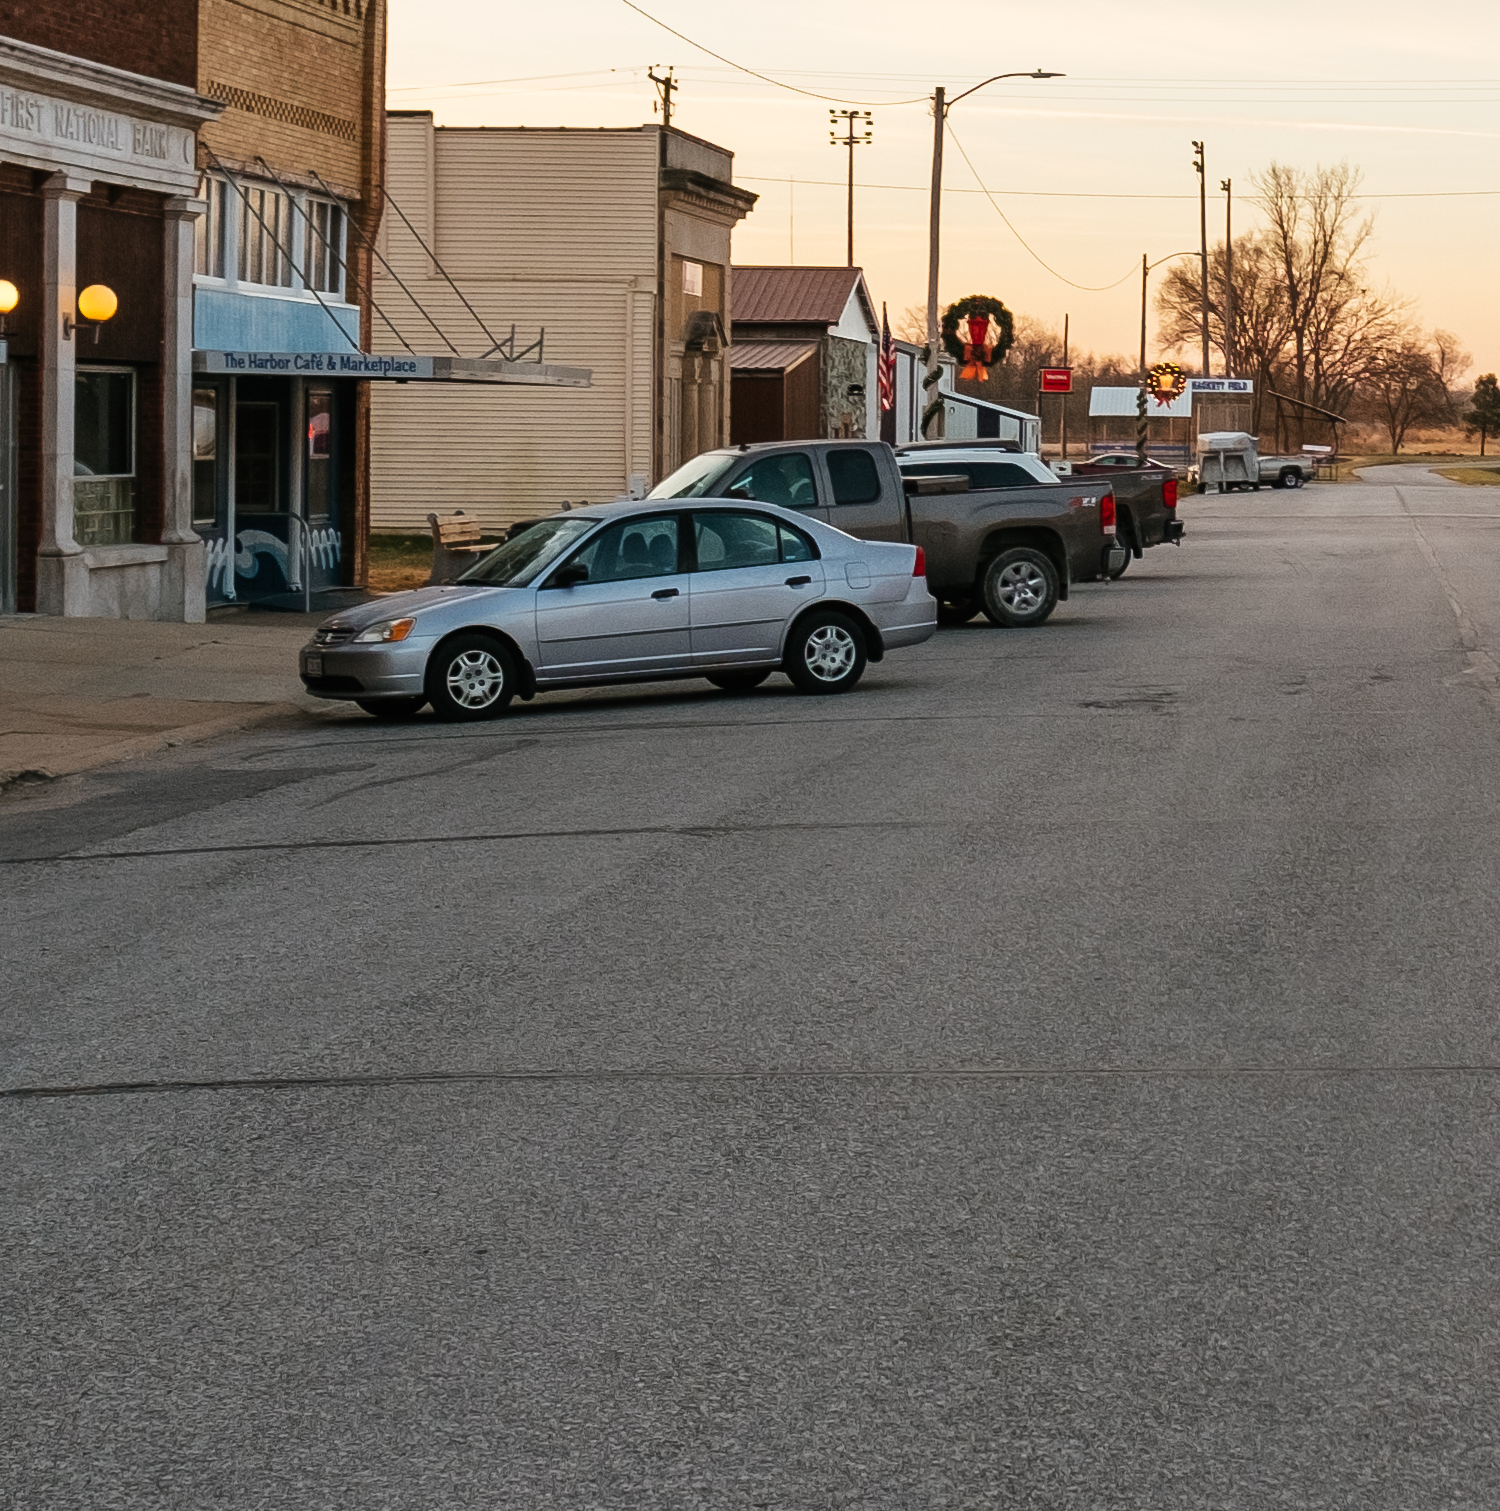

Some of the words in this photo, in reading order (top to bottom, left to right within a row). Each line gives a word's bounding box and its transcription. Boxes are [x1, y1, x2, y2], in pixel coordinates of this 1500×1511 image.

[1, 90, 44, 133] FIRST
[54, 103, 123, 152] NATIONAL
[132, 122, 168, 160] BANK
[223, 352, 246, 369] The
[248, 355, 291, 370] Harbor
[293, 354, 324, 371] Café
[326, 357, 337, 371] &
[339, 356, 417, 376] Marketplace
